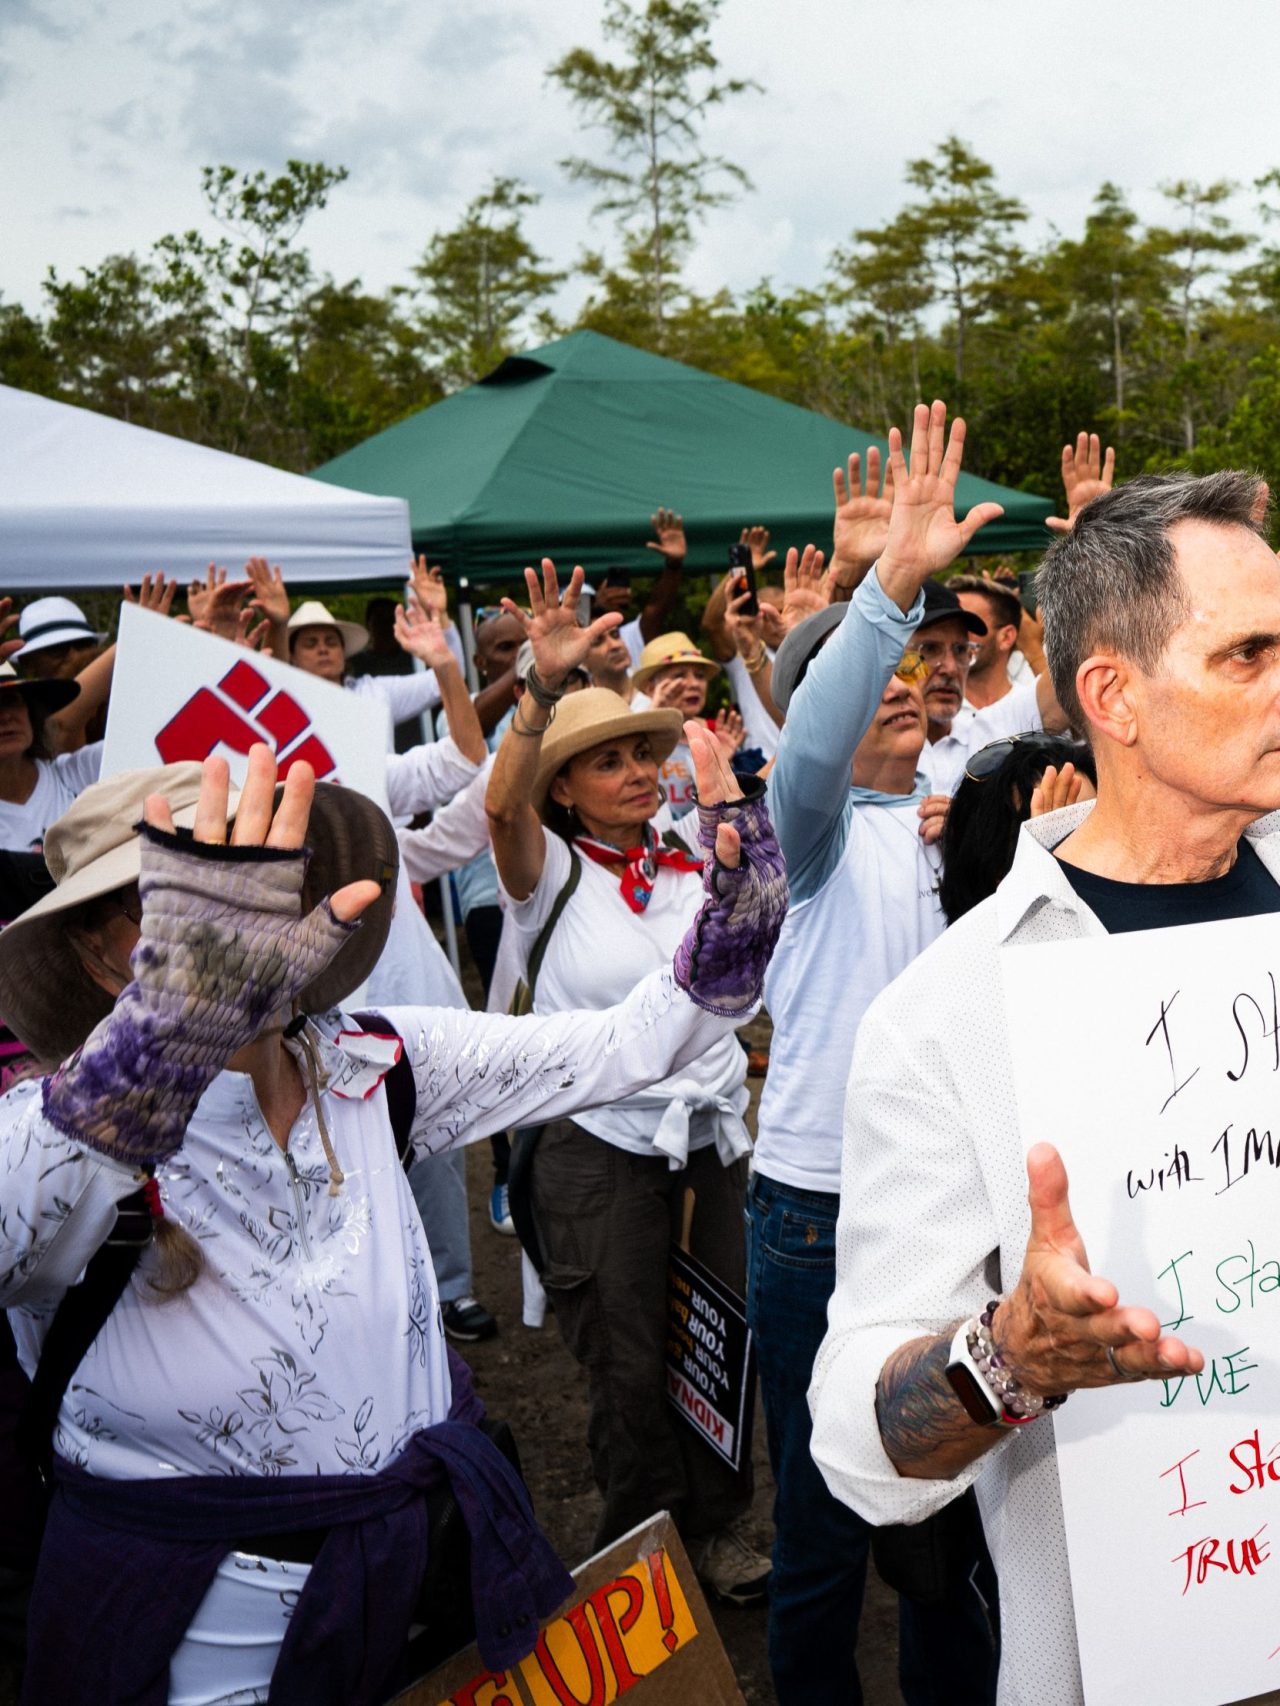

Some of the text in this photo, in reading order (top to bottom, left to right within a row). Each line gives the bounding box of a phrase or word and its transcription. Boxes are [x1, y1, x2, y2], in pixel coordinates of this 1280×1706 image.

[1146, 989, 1200, 1114] I
[1127, 1144, 1205, 1199] with
[692, 1289, 727, 1337] YOUR
[1156, 1249, 1196, 1331] I
[688, 1314, 725, 1361] YOUR
[683, 1354, 718, 1401] YOUR
[695, 1343, 730, 1390] YOUR
[1160, 1347, 1258, 1406] DUE
[1159, 1449, 1206, 1517] I
[1171, 1523, 1271, 1596] TRUE
